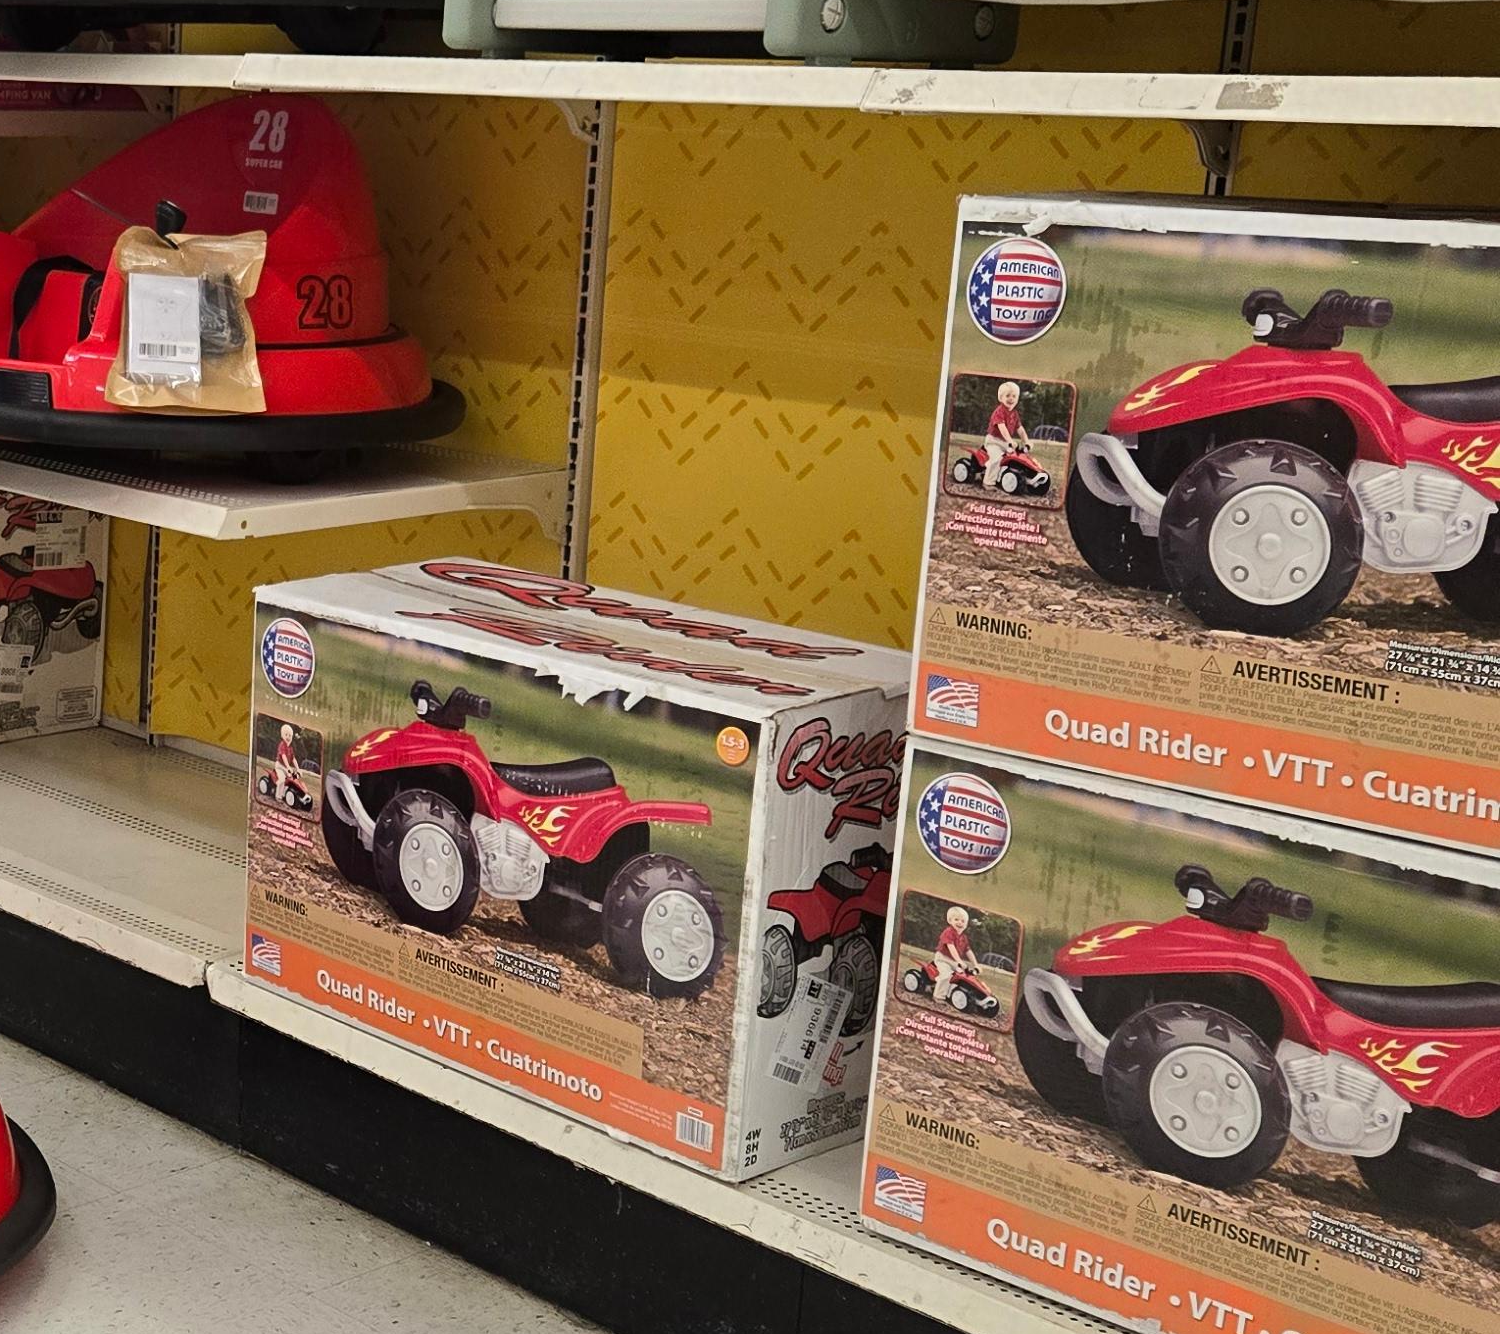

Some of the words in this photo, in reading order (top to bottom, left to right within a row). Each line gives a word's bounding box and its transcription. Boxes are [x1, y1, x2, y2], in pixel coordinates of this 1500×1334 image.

[249, 109, 290, 153] 28
[999, 260, 1060, 280] AMERICAN
[296, 274, 354, 330] 28
[996, 284, 1045, 300] PLASTIC
[995, 306, 1027, 322] TOYS
[954, 511, 993, 526] Direction
[970, 503, 986, 514] Full
[987, 505, 1026, 521] Steering!
[965, 524, 998, 537] volante
[998, 529, 1048, 545] totalmente
[973, 537, 1015, 550] operable!
[955, 610, 1032, 641] WARNING:
[277, 634, 312, 652] AMERICAN
[277, 652, 303, 667] PLASTIC
[1388, 650, 1403, 661] 27
[1430, 657, 1445, 667] 21
[1476, 663, 1490, 674] 14
[277, 668, 295, 680] TOYS
[1232, 660, 1389, 701] AVERTISSEMENT
[1385, 660, 1419, 676] (71cm
[1430, 668, 1462, 682] 55cm
[1043, 708, 1130, 750] Quad
[1138, 725, 1228, 768] Rider
[1262, 749, 1333, 788] VTT
[1363, 770, 1500, 822] Cuatrim
[946, 793, 1004, 820] AMERICAN
[944, 814, 990, 836] PLASTIC
[943, 835, 975, 854] TOYS
[264, 888, 309, 917] WARNING:
[414, 947, 499, 991] AVERTISSEMENT
[316, 969, 365, 1006] Quad
[368, 987, 416, 1025] Rider
[433, 1015, 472, 1048] VTT
[486, 1038, 603, 1103] Cuatrimoto
[905, 1017, 944, 1037] Direction
[920, 1012, 936, 1025] Full
[937, 1018, 976, 1038] Steering!
[916, 1031, 948, 1048] volante
[948, 1041, 997, 1064] totalmente
[923, 1044, 966, 1064] operable!
[745, 1128, 761, 1141] 4W
[904, 1109, 980, 1151] WARNING:
[745, 1141, 759, 1155] 8H
[744, 1154, 758, 1167] 2D
[1167, 1202, 1311, 1269] AVERTISSEMENT
[1310, 1219, 1324, 1231] 27
[1349, 1234, 1362, 1245] 21
[1389, 1248, 1403, 1259] 14
[986, 1217, 1067, 1269] Quad
[1073, 1249, 1156, 1301] Rider
[1307, 1229, 1339, 1247] (71cm
[1348, 1244, 1377, 1261] 55cm
[1386, 1258, 1421, 1278] 37cm)
